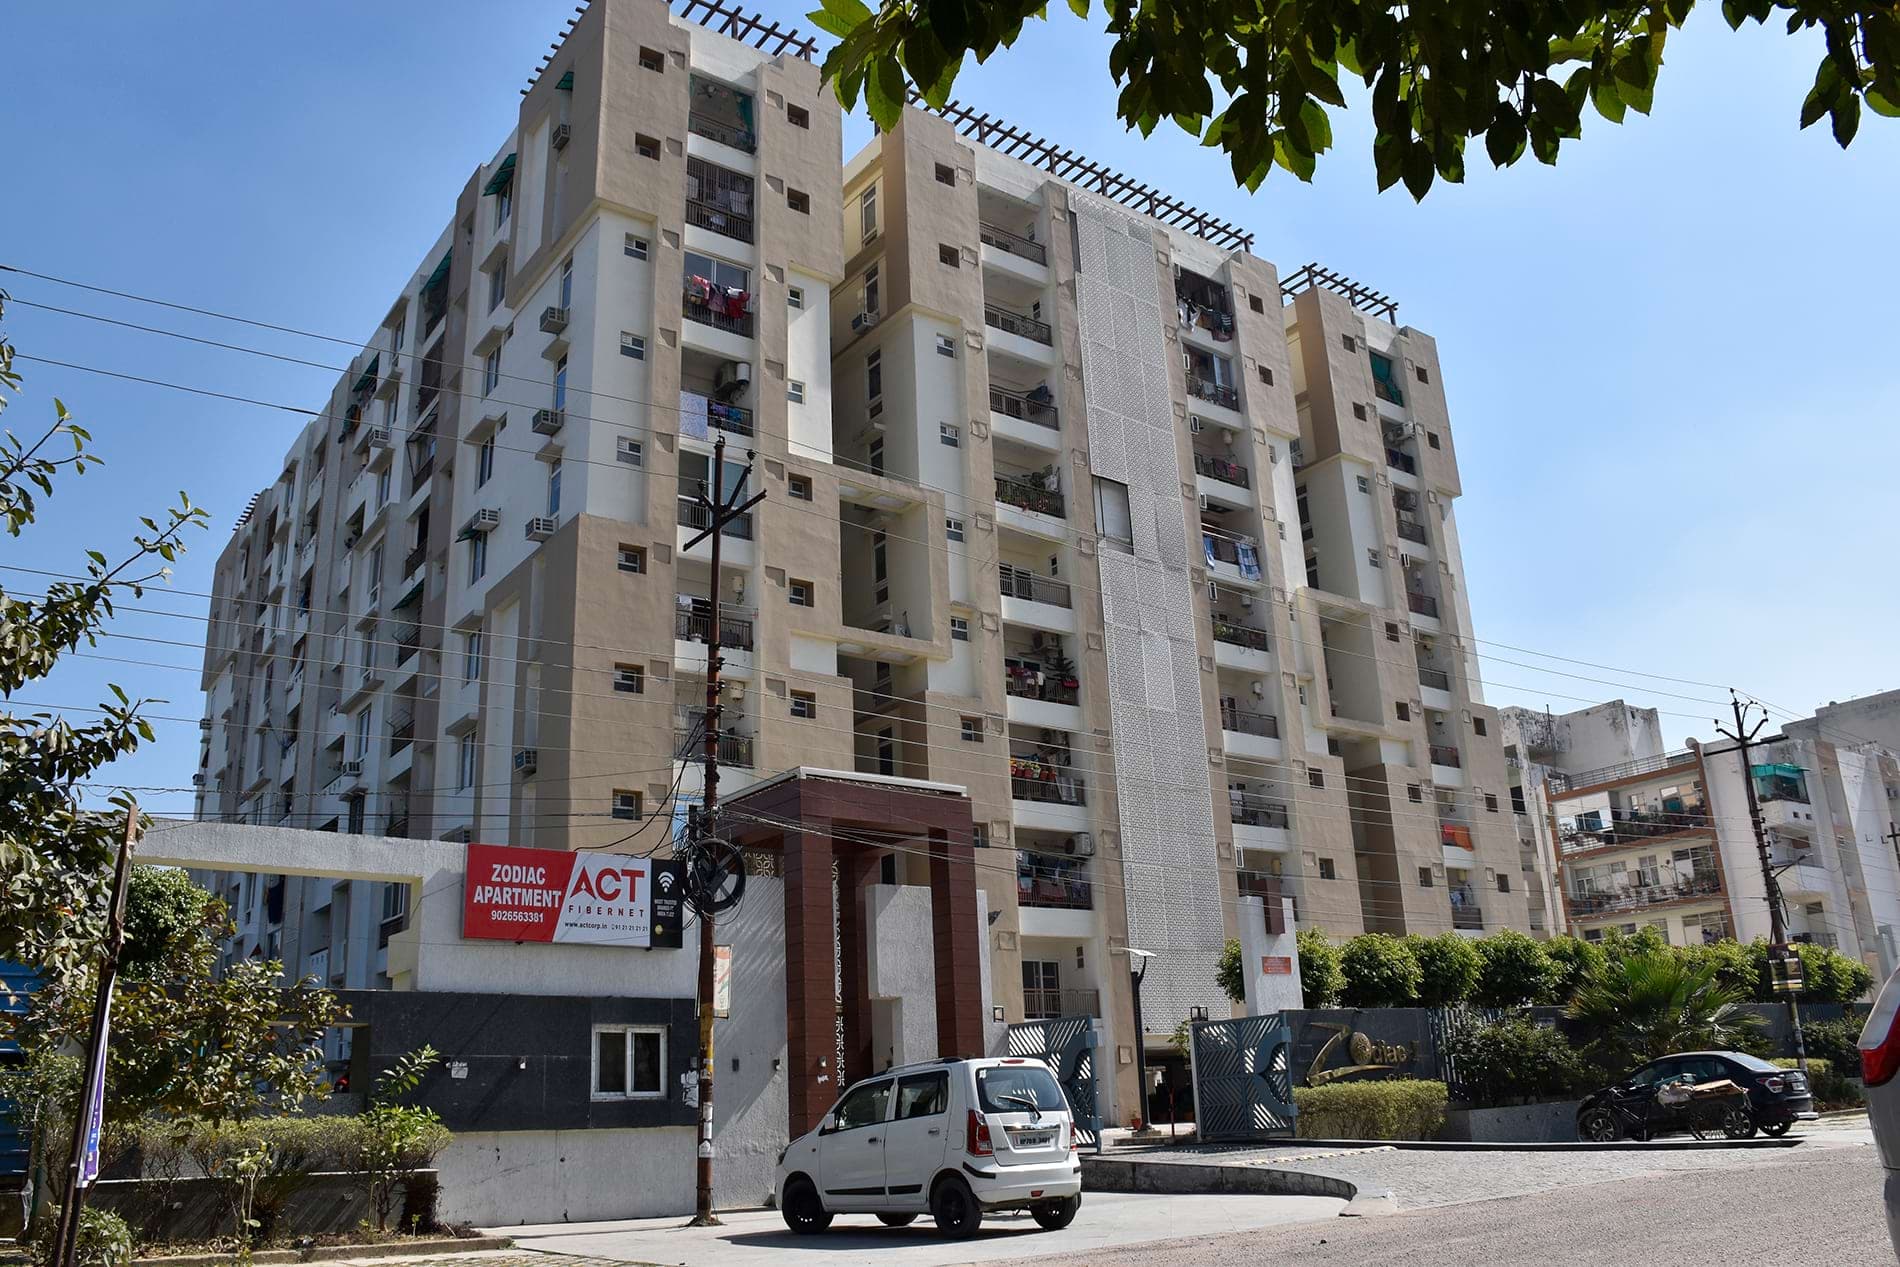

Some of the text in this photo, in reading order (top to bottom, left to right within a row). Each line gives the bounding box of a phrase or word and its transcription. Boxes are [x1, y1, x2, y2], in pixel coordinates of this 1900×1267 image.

[491, 864, 546, 885] ZODIAC
[569, 865, 645, 903] ACT
[473, 885, 562, 908] APARTMENT
[491, 910, 544, 923] 9026563381
[568, 905, 644, 917] FIBERNET
[565, 922, 608, 930] www.actcorp.in
